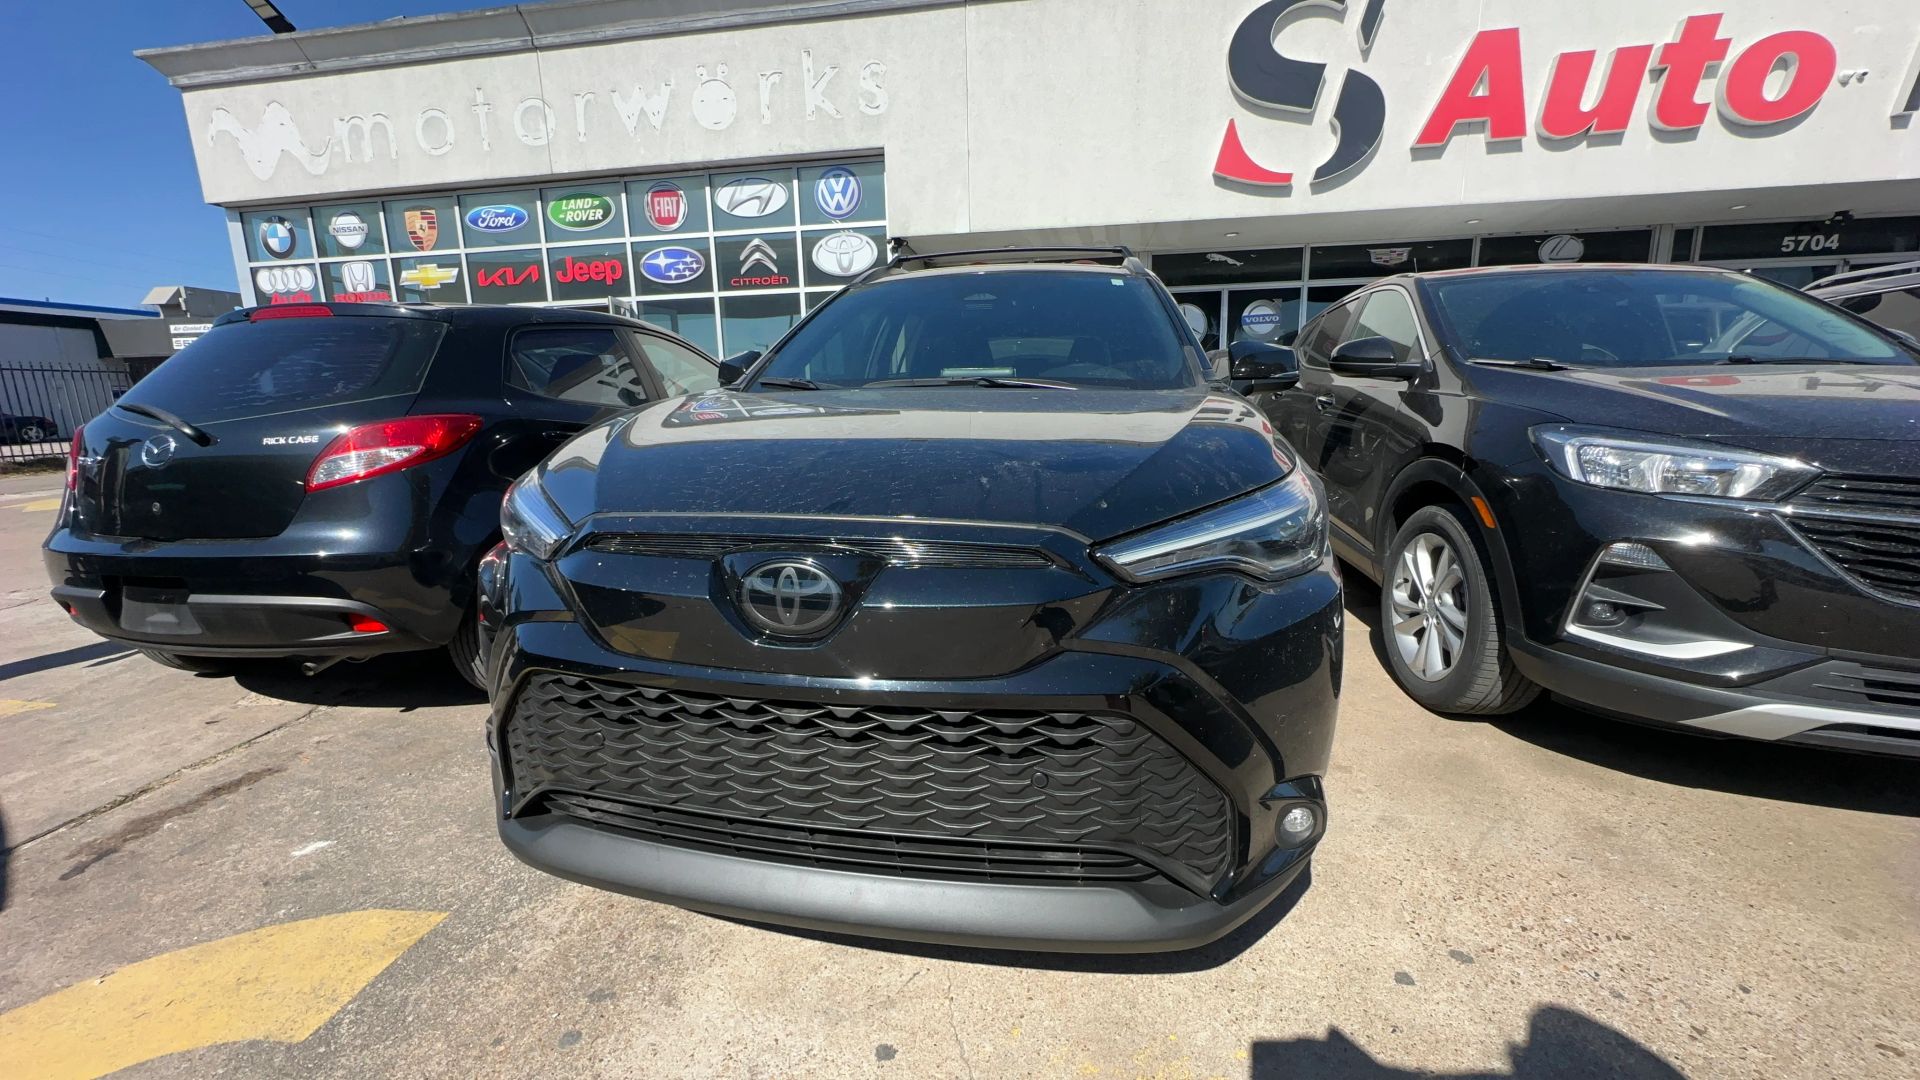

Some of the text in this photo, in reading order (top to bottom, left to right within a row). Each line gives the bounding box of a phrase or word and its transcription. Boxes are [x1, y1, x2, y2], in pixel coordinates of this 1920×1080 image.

[1412, 12, 1837, 147] Auto
[561, 197, 592, 210] LAND
[653, 196, 679, 218] FIAT
[478, 208, 516, 228] Ford
[332, 225, 365, 234] NISSAN
[1781, 233, 1840, 252] 5704
[477, 264, 540, 287] KIA
[555, 255, 623, 286] Jeep
[1243, 314, 1280, 324] VOLVO
[262, 434, 319, 446] RICK CASE
